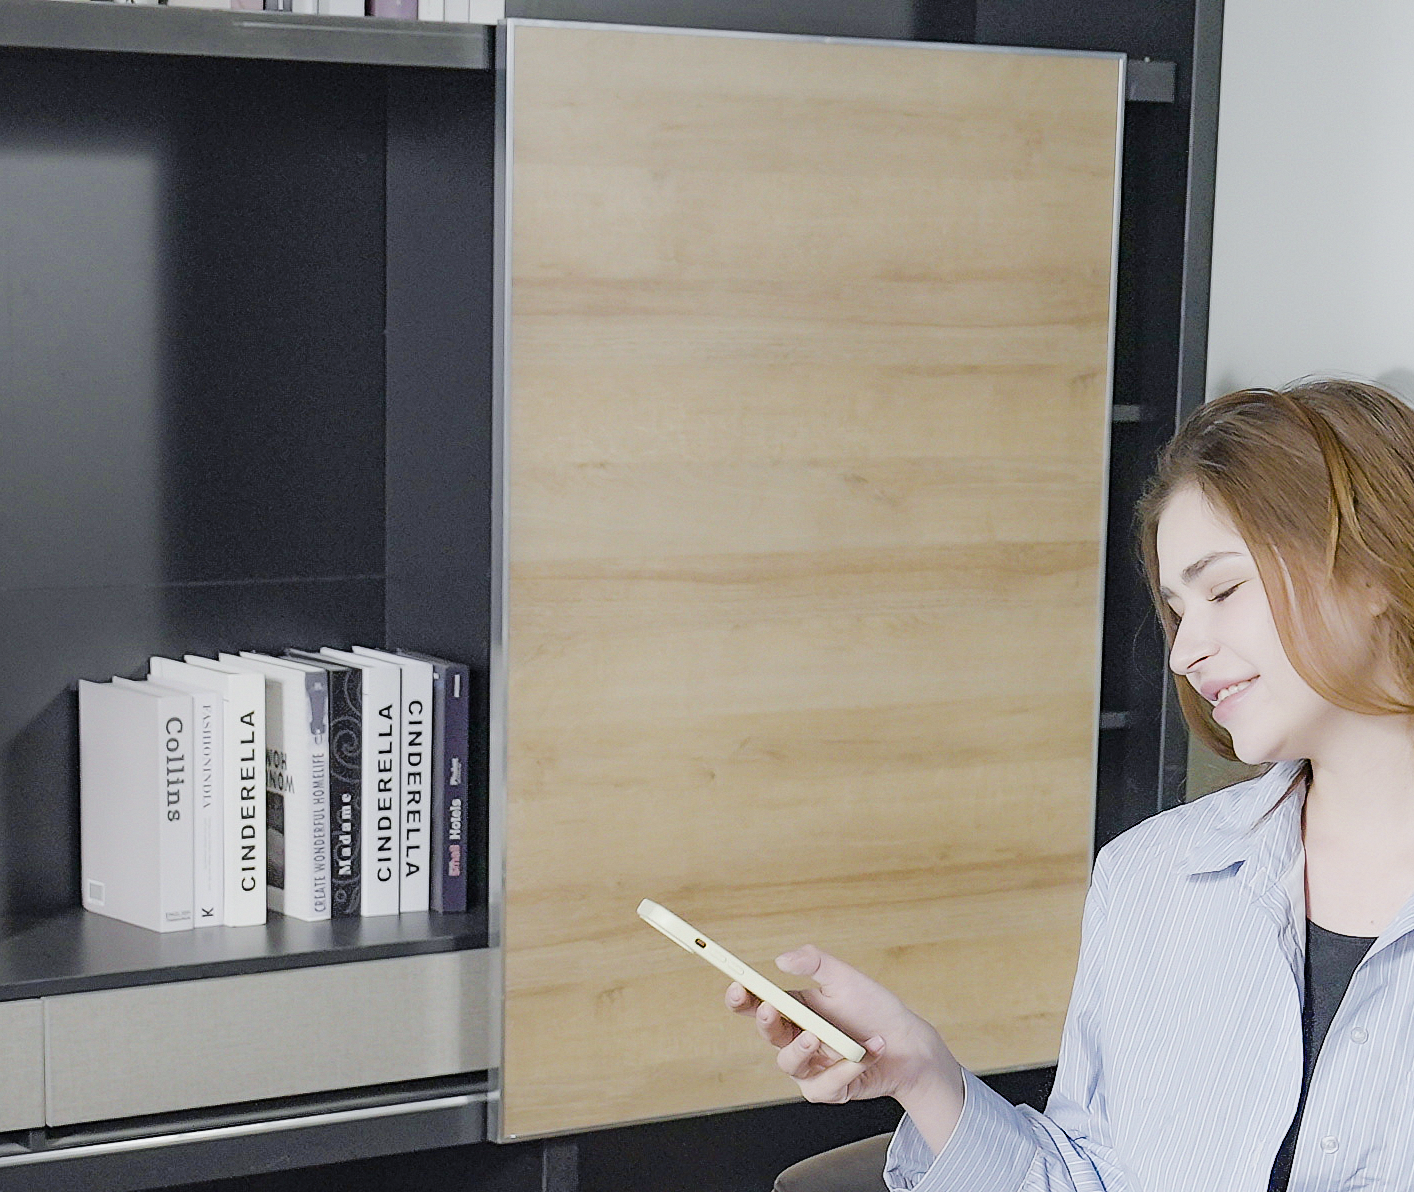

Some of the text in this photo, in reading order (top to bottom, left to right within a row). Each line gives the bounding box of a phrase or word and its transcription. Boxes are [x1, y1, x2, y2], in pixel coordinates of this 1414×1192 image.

[166, 716, 185, 822] Collins
[240, 710, 256, 892] CINDERELLA
[312, 752, 327, 913] CREATE WONDERFUL HOMELIFE
[338, 792, 352, 876] Madame
[377, 703, 393, 882] CINDERELLA
[405, 700, 424, 878] CINDERELLA
[449, 798, 462, 840] Hotels
[201, 907, 214, 918] K
